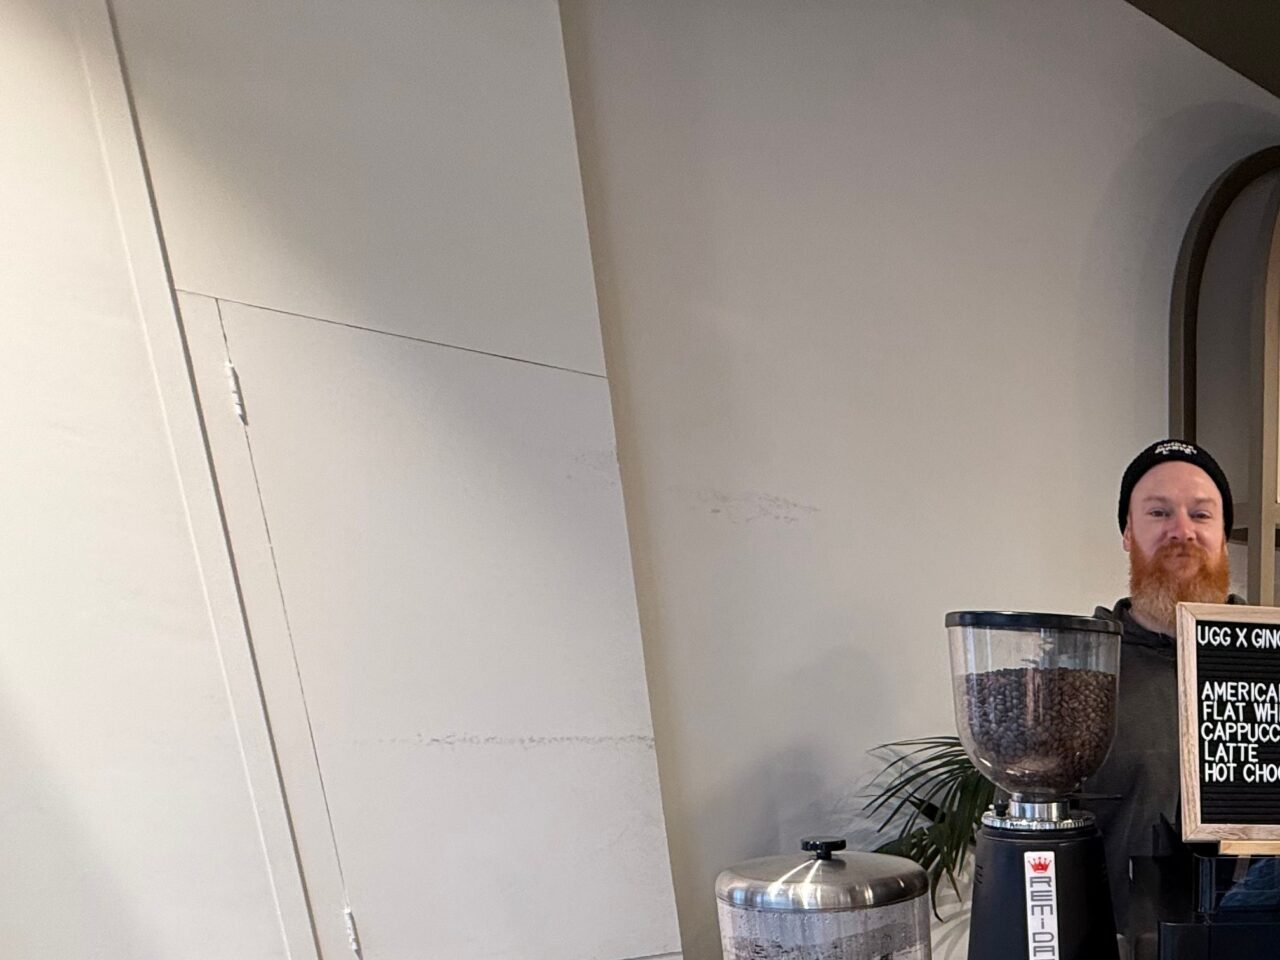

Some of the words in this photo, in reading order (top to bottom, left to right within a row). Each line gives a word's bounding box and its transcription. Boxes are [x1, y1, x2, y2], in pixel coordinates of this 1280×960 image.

[1197, 625, 1232, 647] UGG
[1235, 627, 1248, 648] X
[1202, 700, 1247, 721] FLAT
[1204, 741, 1259, 763] LATTE
[1204, 762, 1237, 783] HOT
